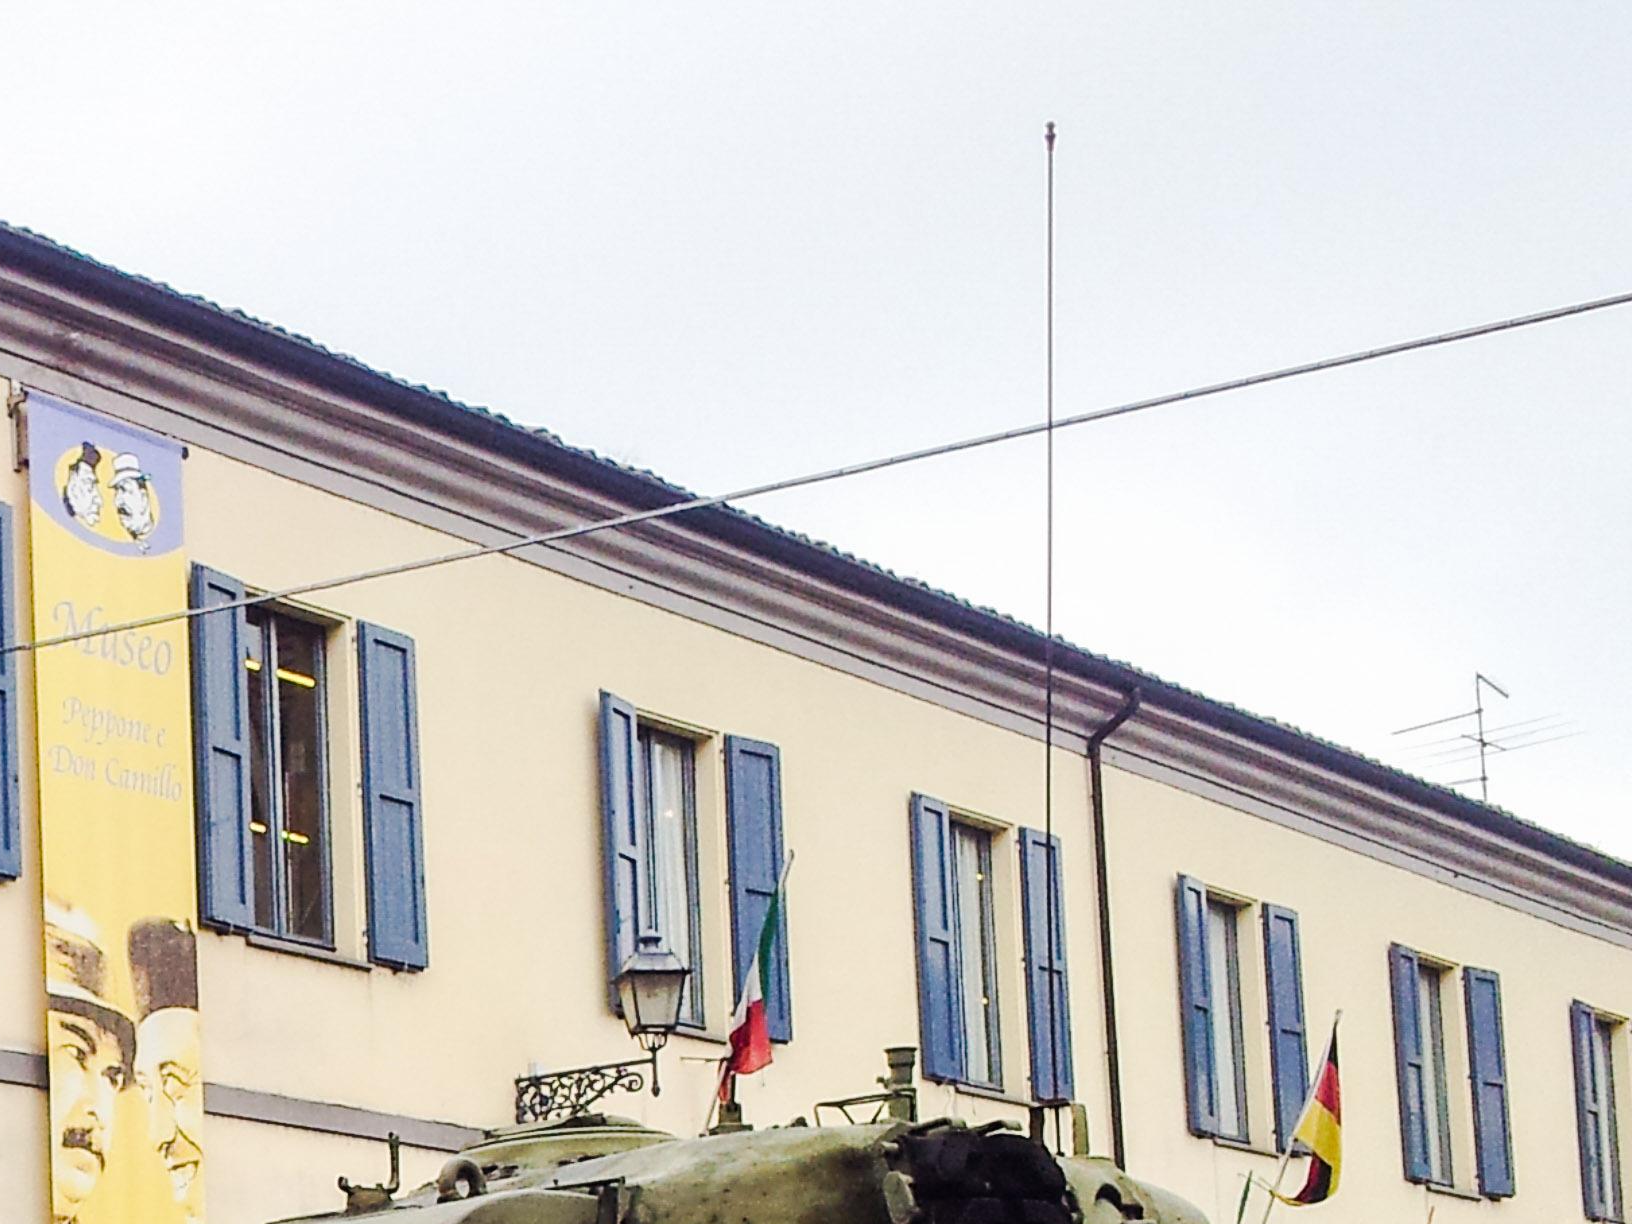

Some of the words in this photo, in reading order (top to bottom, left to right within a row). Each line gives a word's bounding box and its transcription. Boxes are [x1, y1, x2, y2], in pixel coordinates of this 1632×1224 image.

[53, 601, 172, 676] Museo
[62, 695, 152, 747] Peppone
[156, 728, 167, 749] e
[48, 745, 97, 782] Don
[105, 757, 183, 803] Camillo
